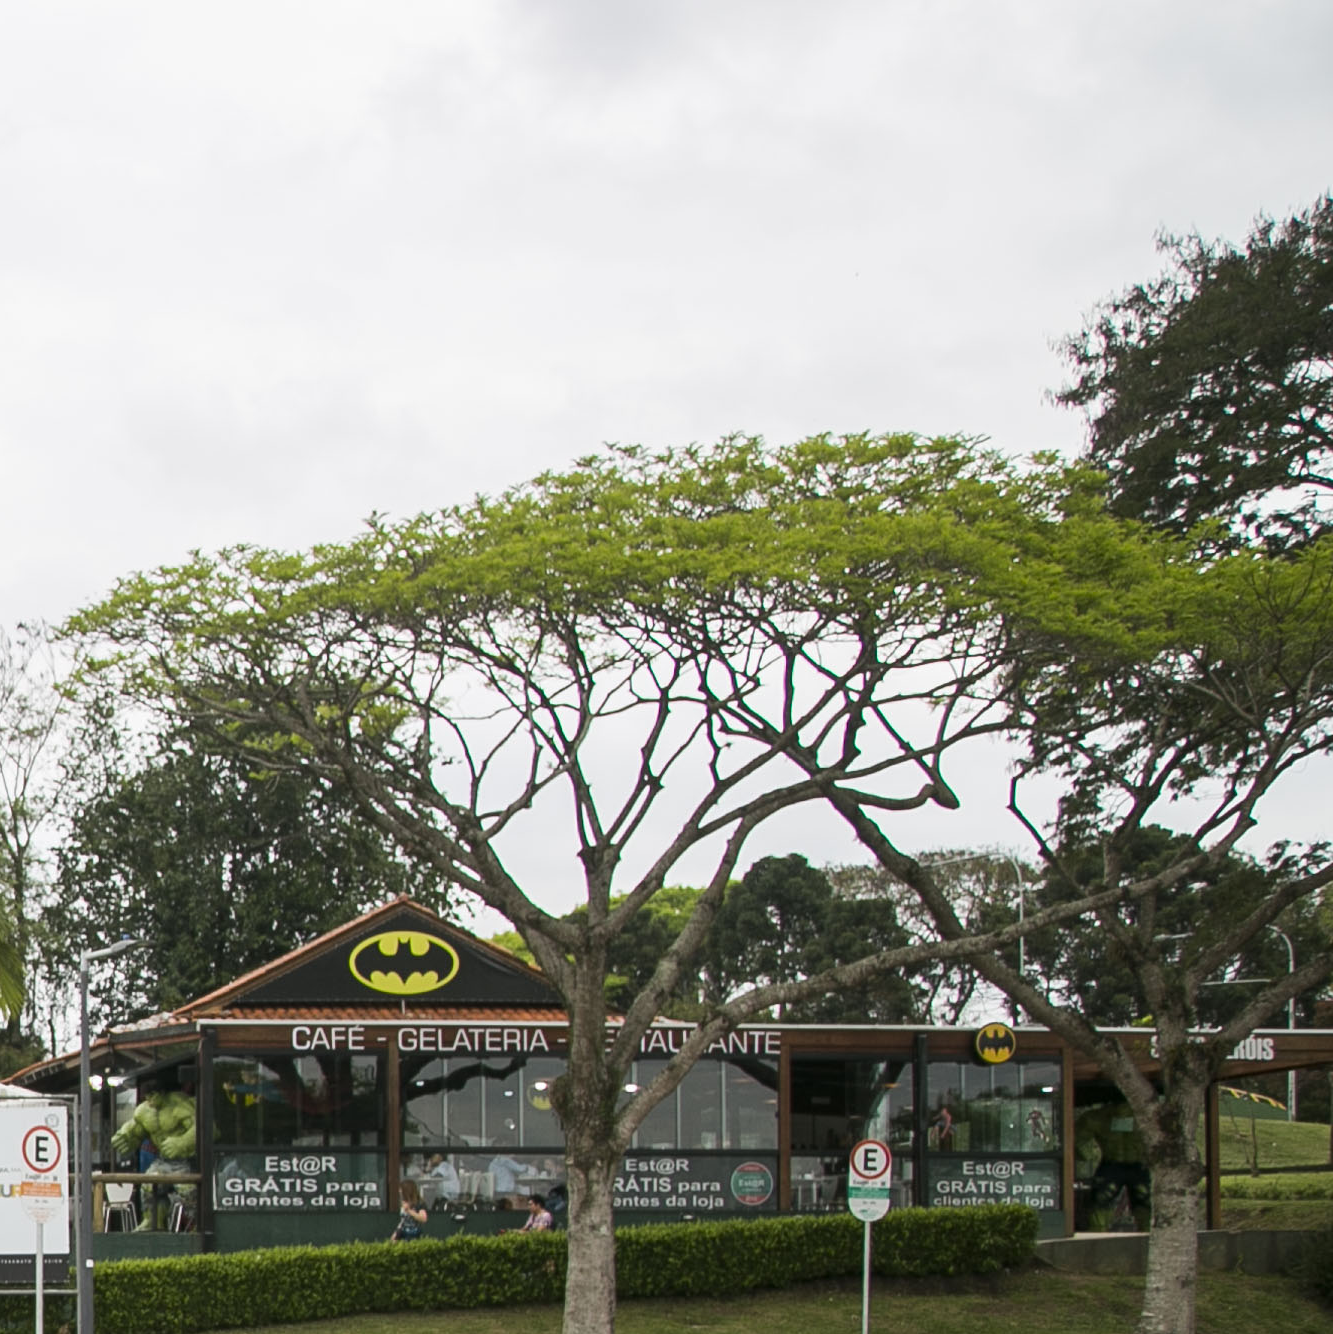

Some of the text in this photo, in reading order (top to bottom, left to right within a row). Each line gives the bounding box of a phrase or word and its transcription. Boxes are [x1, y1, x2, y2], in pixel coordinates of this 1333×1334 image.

[291, 1024, 365, 1050] CAFÉ
[398, 1028, 549, 1052] GELATERIA
[35, 1136, 49, 1163] E
[265, 1155, 337, 1176] Est@R
[625, 1158, 689, 1174] Est@R
[863, 1148, 878, 1171] E
[963, 1161, 1024, 1179] Est@R
[225, 1175, 378, 1194] GRÁTIS para
[613, 1174, 721, 1194] RÁTIS para
[936, 1178, 1052, 1195] GRÁTIS para
[221, 1195, 381, 1209] clientes da loja
[665, 1195, 687, 1207] da
[693, 1195, 724, 1209] loja
[1025, 1196, 1055, 1208] loja
